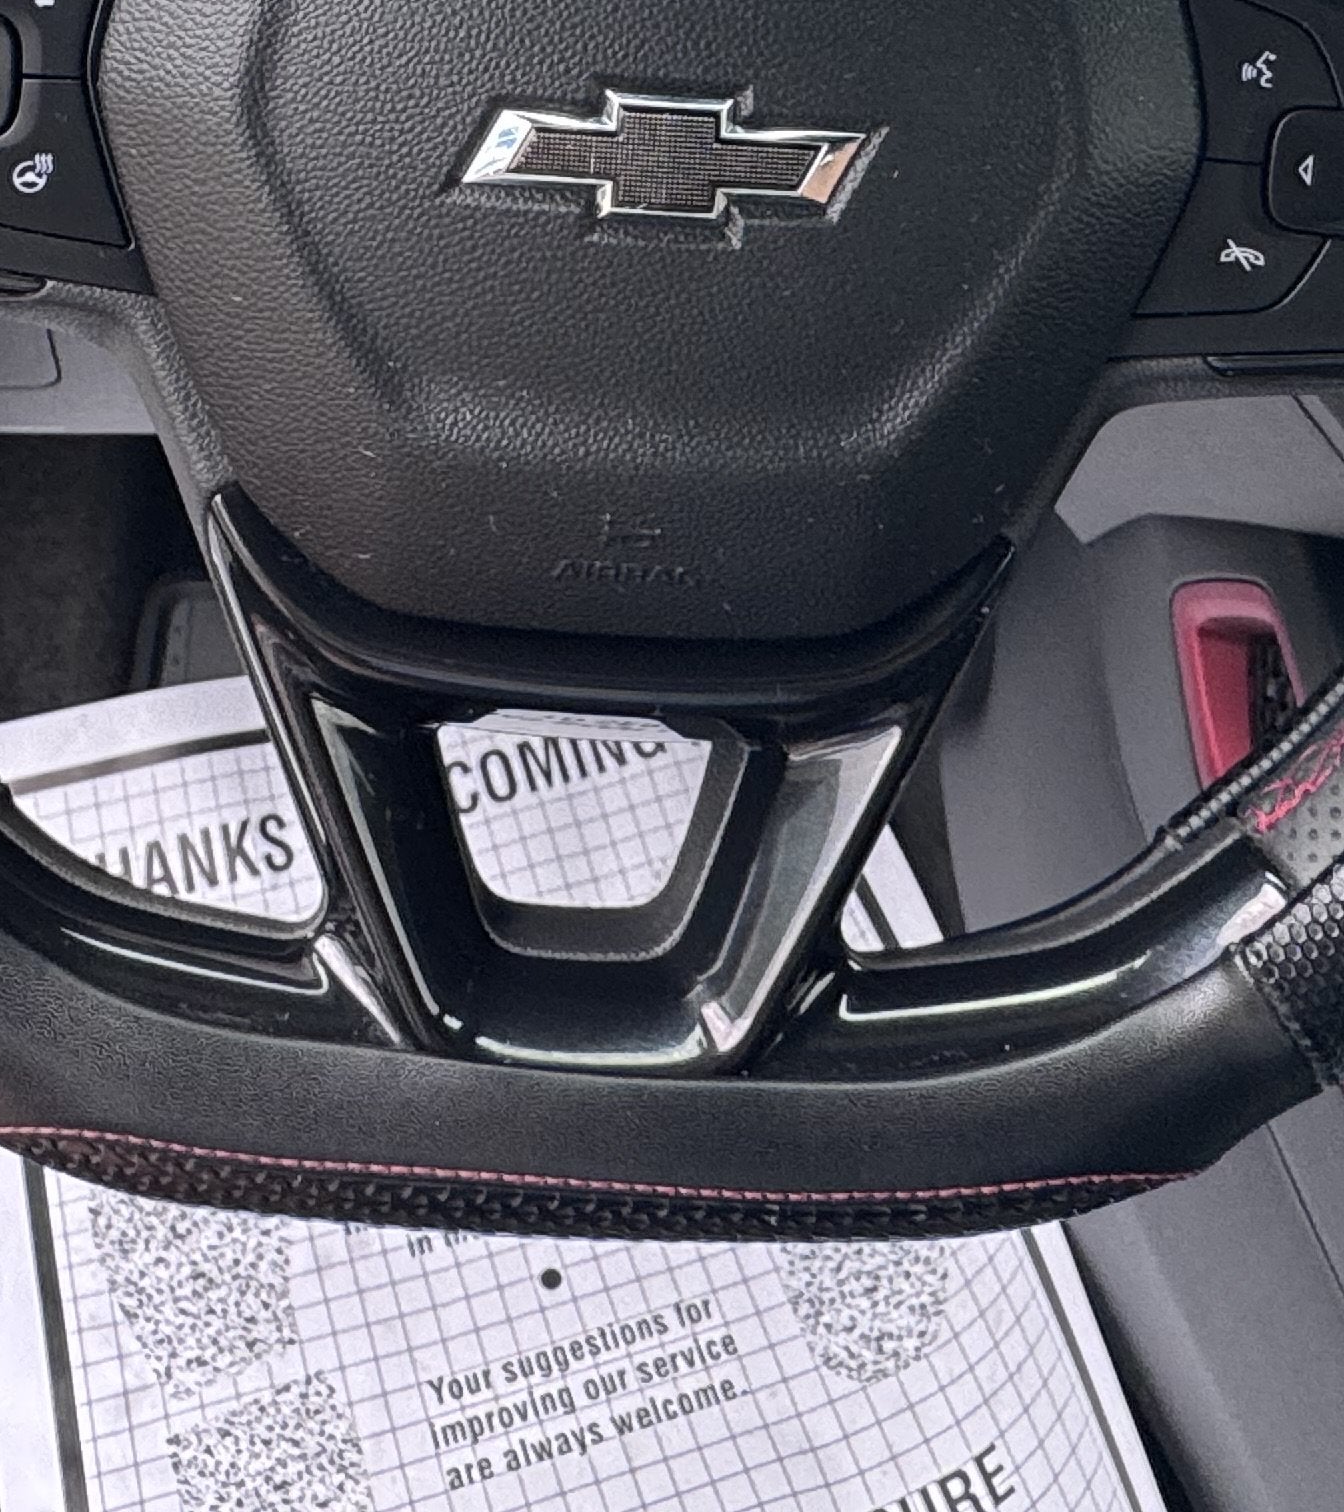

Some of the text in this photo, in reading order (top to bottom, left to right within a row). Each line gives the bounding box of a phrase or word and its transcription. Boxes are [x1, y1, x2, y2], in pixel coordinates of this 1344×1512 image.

[426, 1298, 713, 1406] Your suggestions for
[428, 1333, 740, 1450] improving our service
[445, 1377, 750, 1492] are always welcome.
